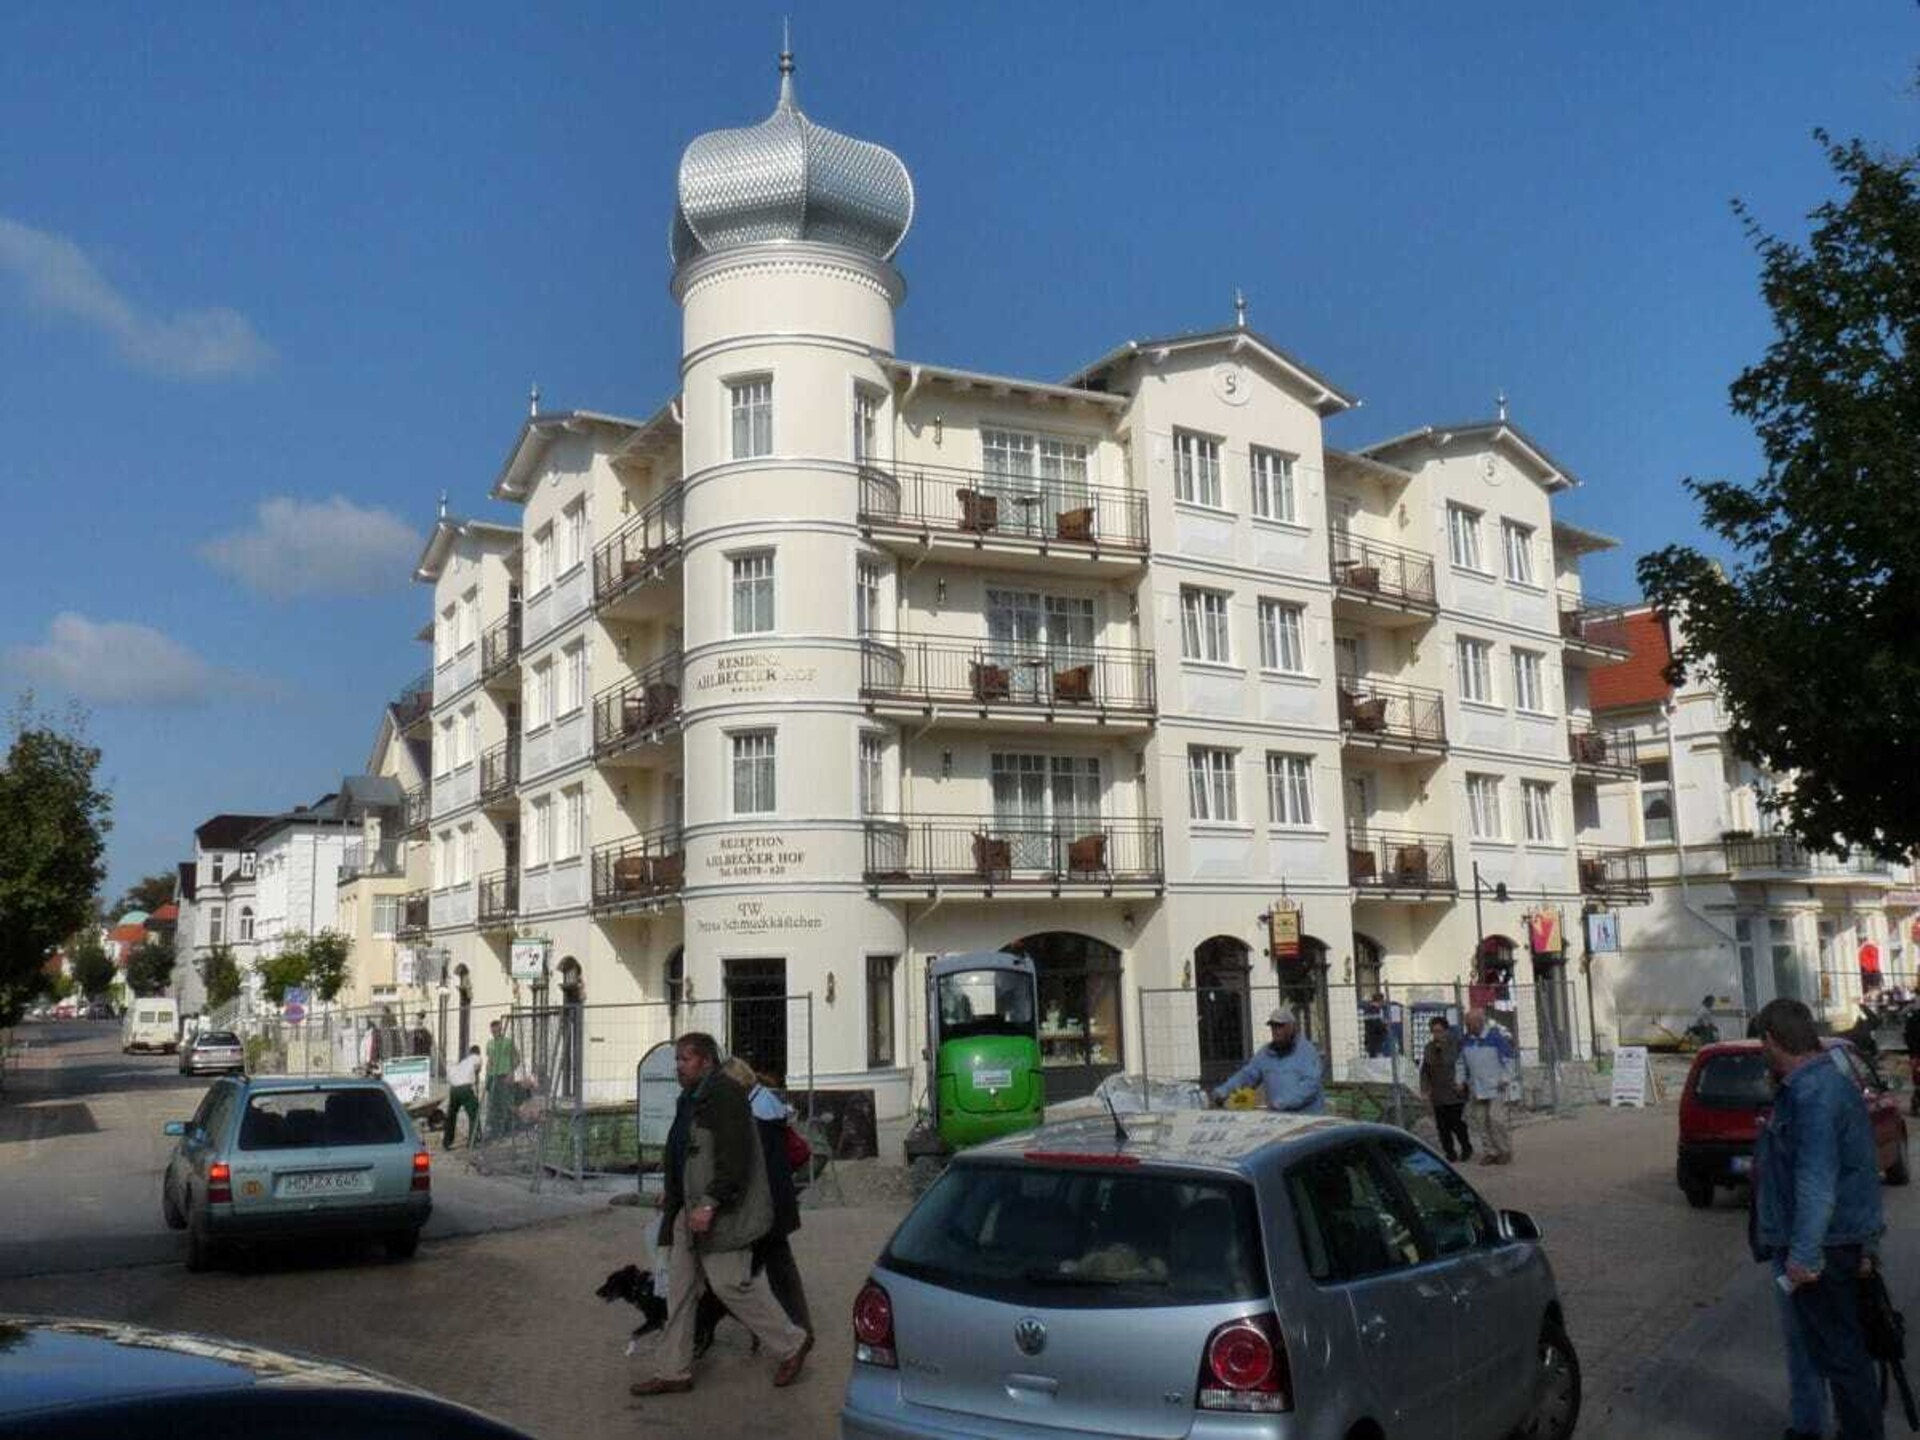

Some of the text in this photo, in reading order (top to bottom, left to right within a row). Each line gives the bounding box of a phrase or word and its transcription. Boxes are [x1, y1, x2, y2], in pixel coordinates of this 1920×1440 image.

[697, 669, 777, 691] AHLBECKER
[720, 836, 784, 849] REZEPTION
[705, 851, 806, 868] AHLBECKER HOF
